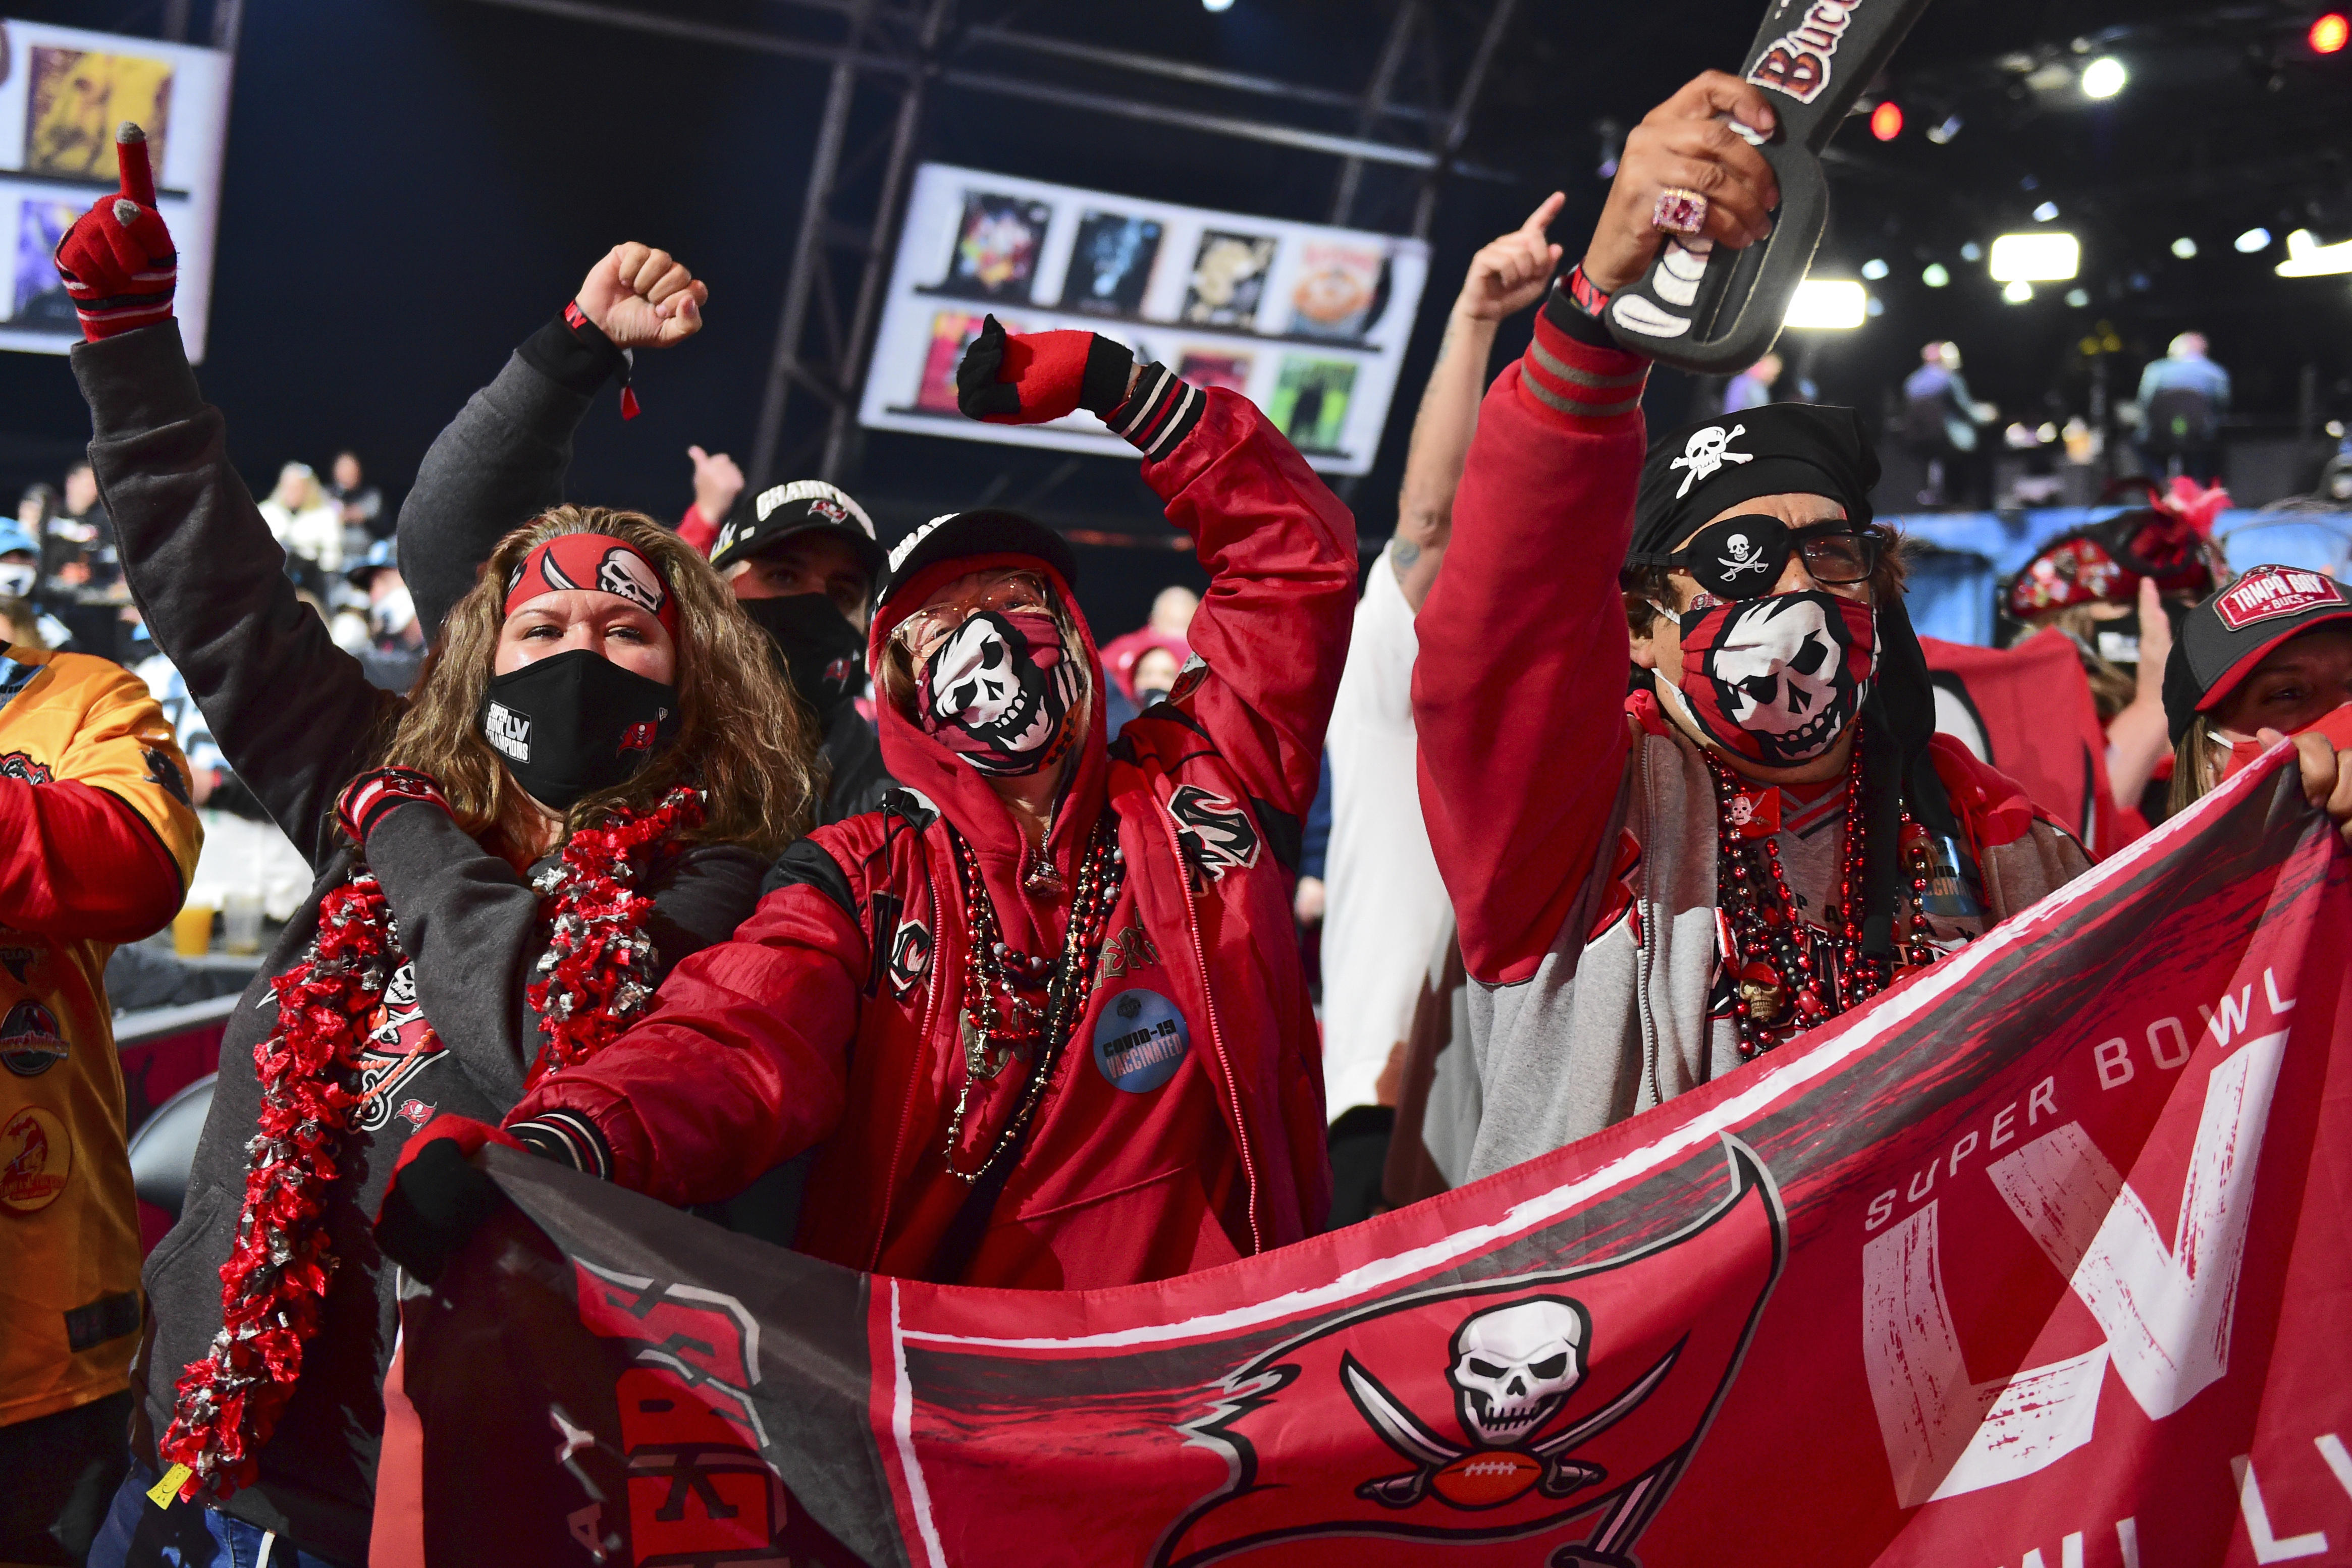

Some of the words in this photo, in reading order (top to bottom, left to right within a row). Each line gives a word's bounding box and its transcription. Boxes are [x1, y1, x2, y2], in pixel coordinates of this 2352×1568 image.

[2230, 575, 2291, 612] TAMPA
[2286, 574, 2325, 593] BAY
[2270, 594, 2304, 609] BUCS
[486, 717, 505, 736] BOWL
[488, 702, 509, 724] SUPER
[505, 715, 530, 742] LV
[485, 729, 528, 761] CHAMPIONS
[1102, 1018, 1177, 1058] COVID-19
[1106, 1033, 1184, 1079] VACCINATED
[1864, 1075, 2058, 1231] SUPER
[2093, 967, 2297, 1091] BOWL
[1862, 1026, 2292, 1509] LV
